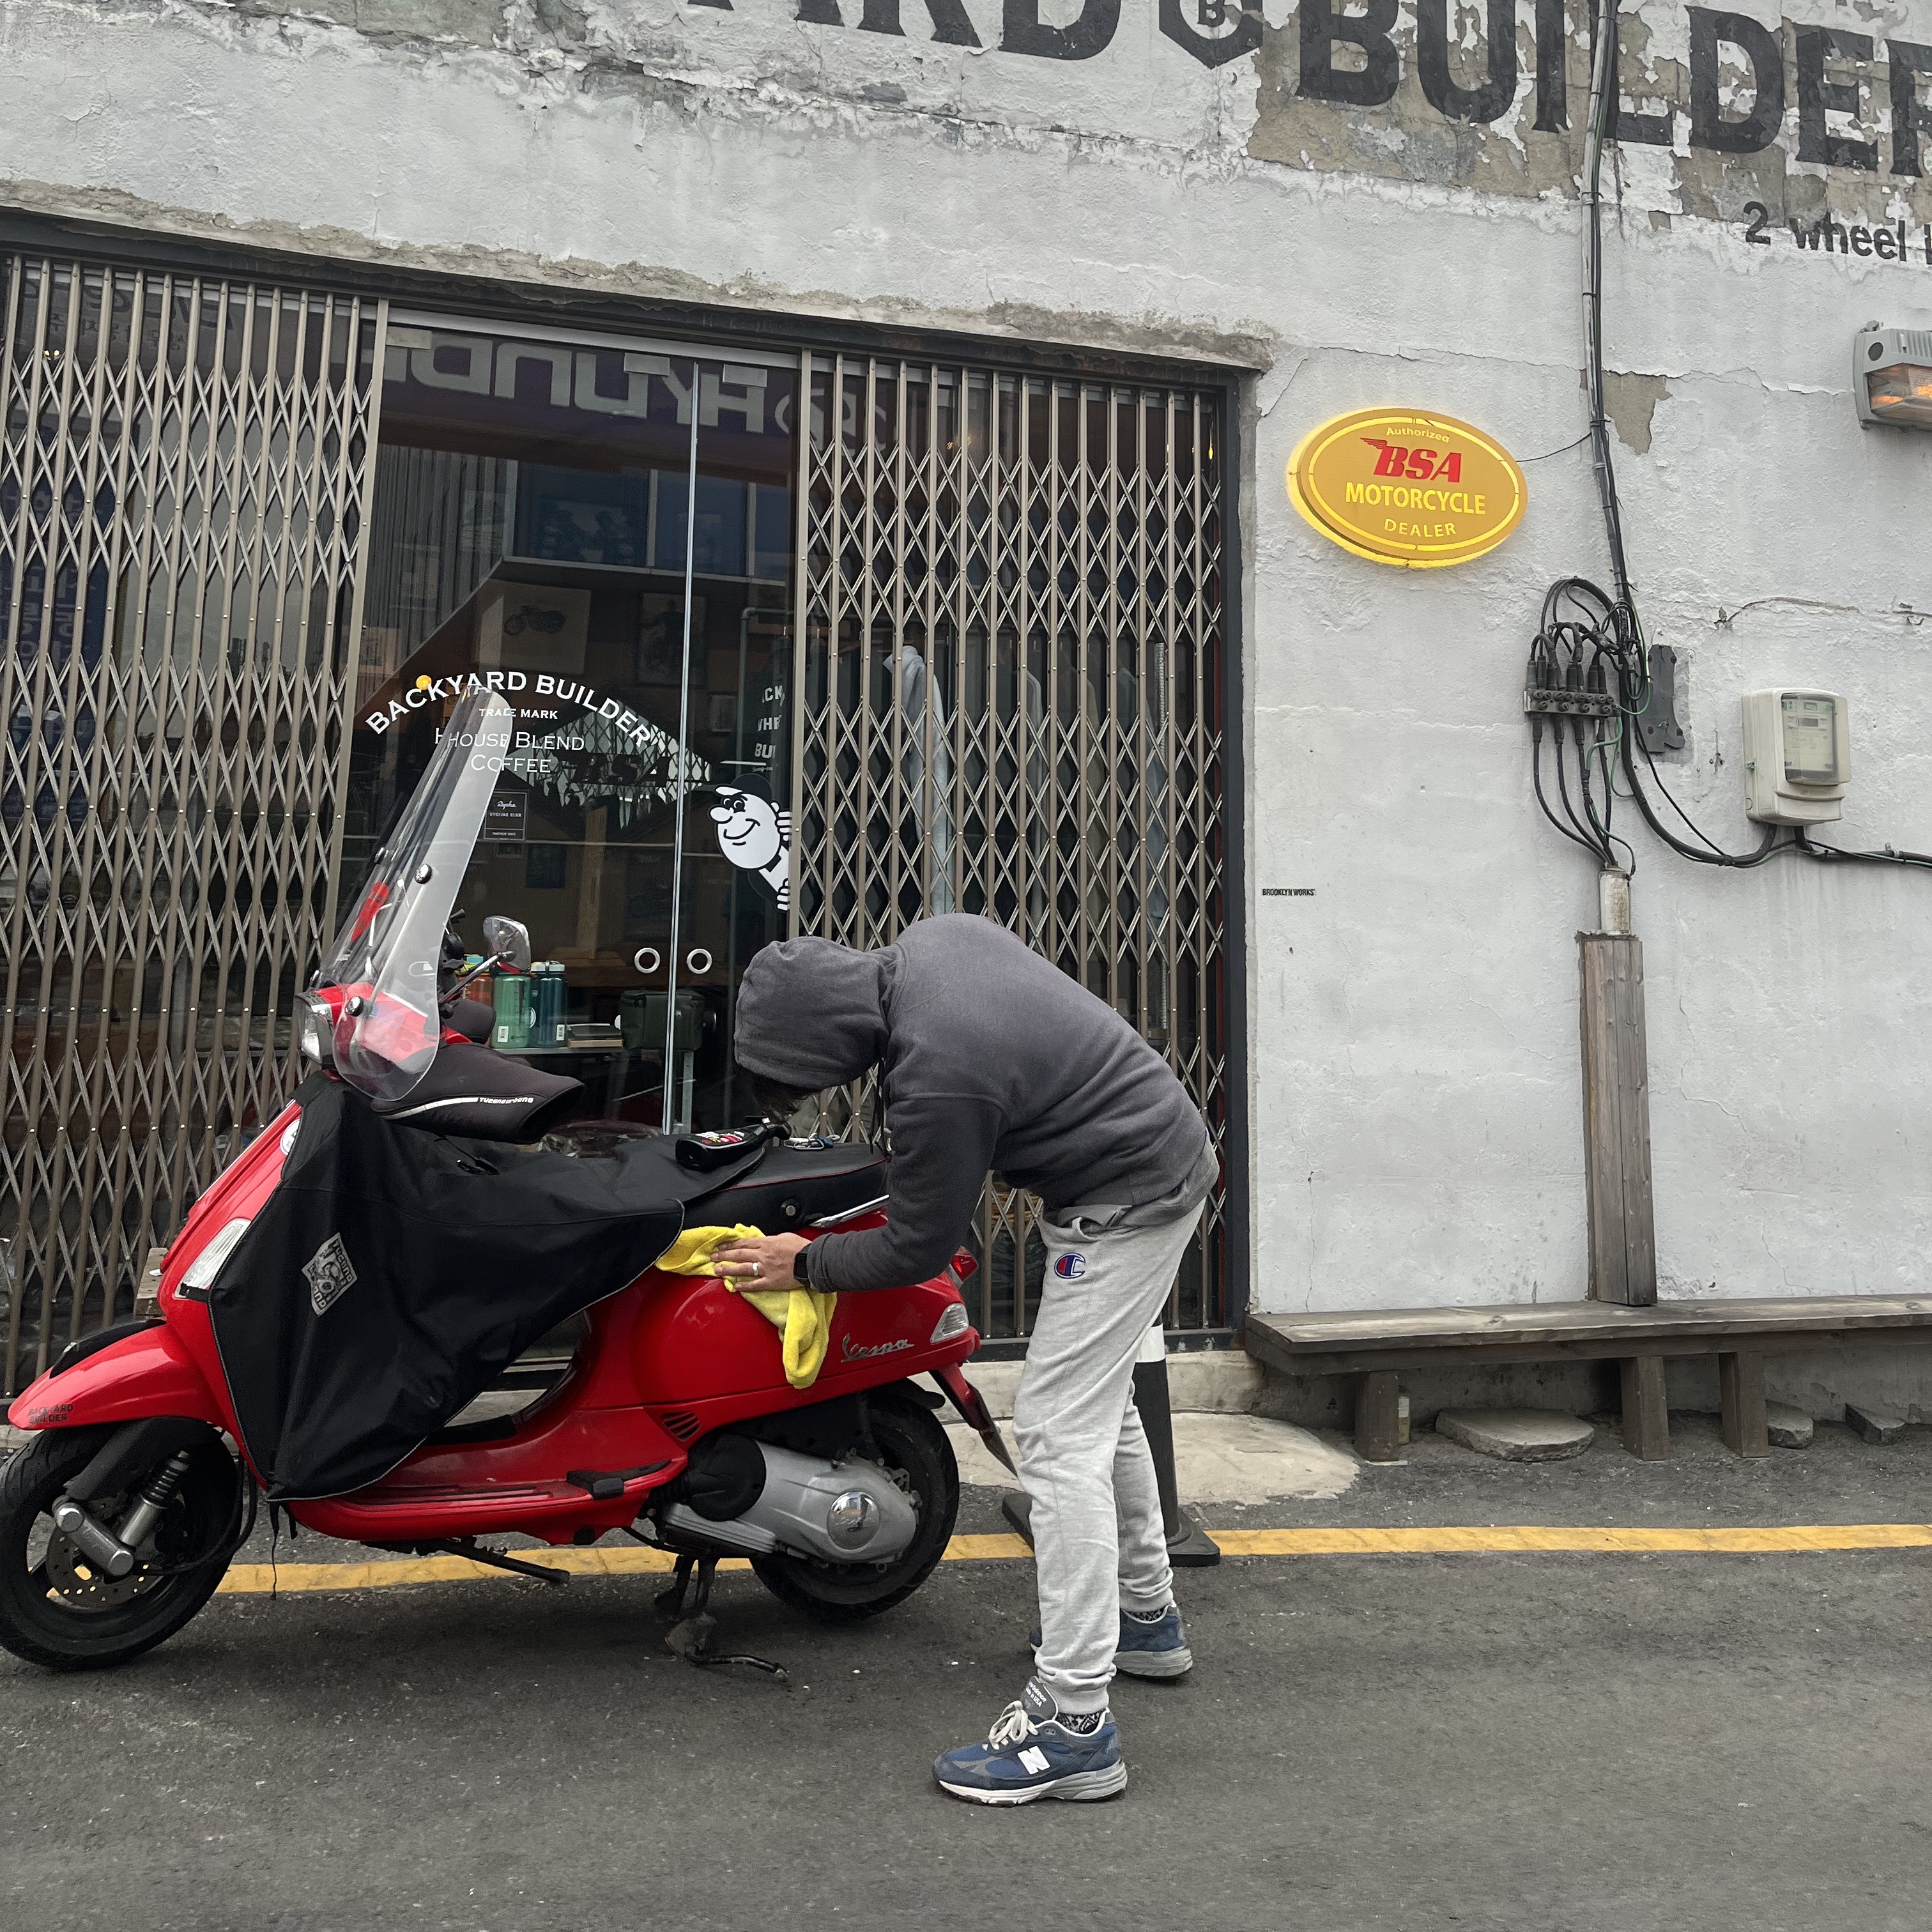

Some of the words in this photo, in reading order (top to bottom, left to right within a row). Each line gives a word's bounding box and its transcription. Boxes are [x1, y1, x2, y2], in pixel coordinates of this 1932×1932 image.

[1744, 201, 1771, 246] 2
[1789, 211, 1907, 262] wheel
[1386, 427, 1450, 443] Authorized
[1372, 445, 1462, 483] BSA
[1346, 482, 1486, 515] MOTORCYCLE
[1384, 518, 1457, 537] DEALER
[365, 671, 526, 735] BACKYARD
[535, 674, 652, 747] BUILDER
[521, 709, 558, 719] MARK
[471, 755, 551, 774] COFFEE
[841, 1332, 915, 1363] Vespa
